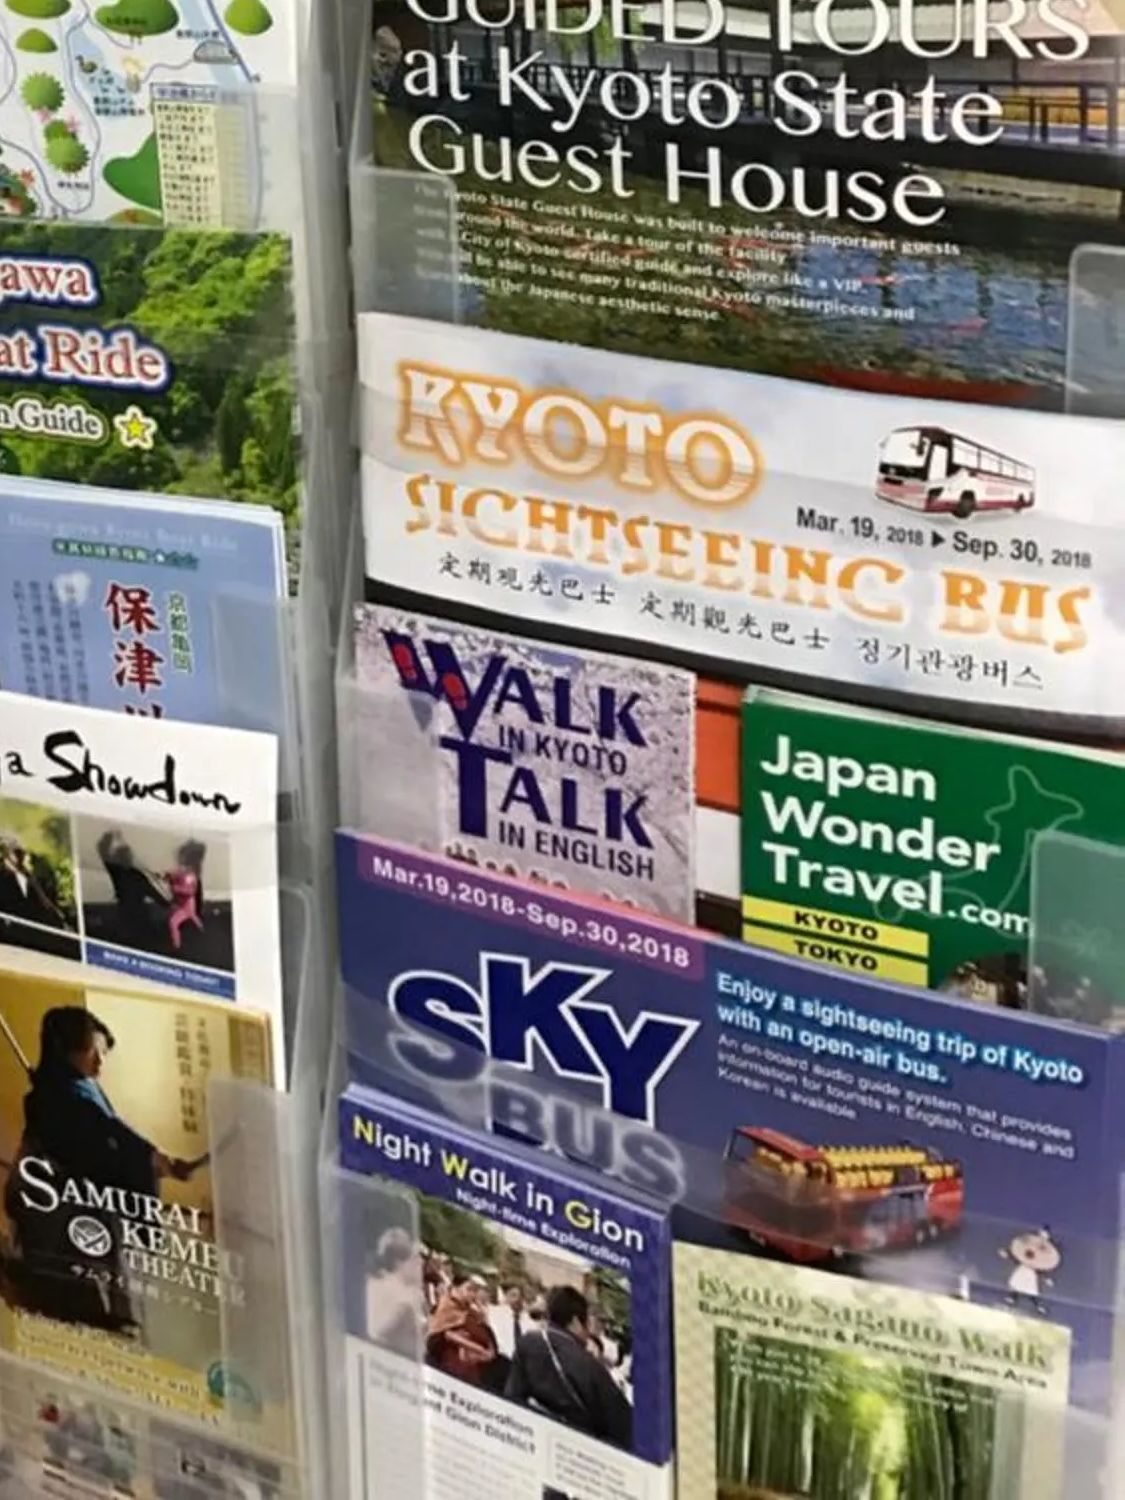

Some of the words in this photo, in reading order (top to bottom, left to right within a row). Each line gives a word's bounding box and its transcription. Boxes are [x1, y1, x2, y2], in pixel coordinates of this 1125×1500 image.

[402, 44, 470, 104] at
[498, 46, 743, 134] Kyoto
[772, 69, 1006, 148] State
[407, 111, 636, 199] Guest
[664, 141, 949, 228] House
[41, 329, 169, 388] Ride
[16, 403, 103, 440] Guide
[399, 360, 759, 501] KYOTO
[796, 507, 848, 535] Mar.
[851, 514, 882, 544] 19,
[885, 525, 924, 546] 2018
[953, 530, 1006, 565] Sep.
[1010, 538, 1046, 566] 30,
[1050, 546, 1093, 570] 2018
[939, 566, 1093, 654] BUS
[381, 631, 648, 751] WALK
[856, 637, 1045, 691] 정기관광버스
[44, 731, 243, 813] Showdown
[498, 723, 530, 750] IN
[532, 730, 628, 778] KYOTO
[760, 735, 937, 802] Japan
[439, 735, 656, 851] TALK
[761, 792, 1002, 873] Wonder
[498, 821, 528, 850] IN
[534, 827, 656, 884] ENGLISH
[370, 855, 693, 972] Mar.19,2018-Sep.30,2018
[793, 910, 880, 943] KYOTO
[793, 939, 880, 973] TOKYO
[388, 951, 699, 1124] SKY
[715, 972, 778, 1012] Enjoy
[781, 992, 797, 1011] a
[800, 1000, 931, 1055] sightseeing
[936, 1032, 975, 1063] trip
[982, 1040, 1010, 1065] of
[1012, 1048, 1084, 1088] Kyoto
[716, 1003, 761, 1031] with
[766, 1022, 794, 1043] an
[799, 1030, 892, 1069] open-air
[896, 1053, 948, 1085] bus.
[741, 1041, 809, 1073] on-board
[1000, 1112, 1073, 1142] provides
[970, 1123, 1040, 1153] Chinese
[18, 1155, 203, 1236] SAMURAI
[352, 1114, 433, 1167] Night
[440, 1149, 519, 1202] Walk
[526, 1182, 555, 1218] in
[563, 1199, 646, 1254] Gion
[455, 1186, 538, 1232] Night-time
[540, 1220, 632, 1271] Exploration
[697, 1270, 805, 1313] Kyoto
[809, 1295, 949, 1345] Sagano
[957, 1328, 1051, 1371] Walk
[698, 1301, 771, 1328] Bamboo
[772, 1314, 830, 1342] Forest
[852, 1332, 943, 1367] Preserved
[947, 1351, 1000, 1380] Town
[1002, 1364, 1048, 1391] Area
